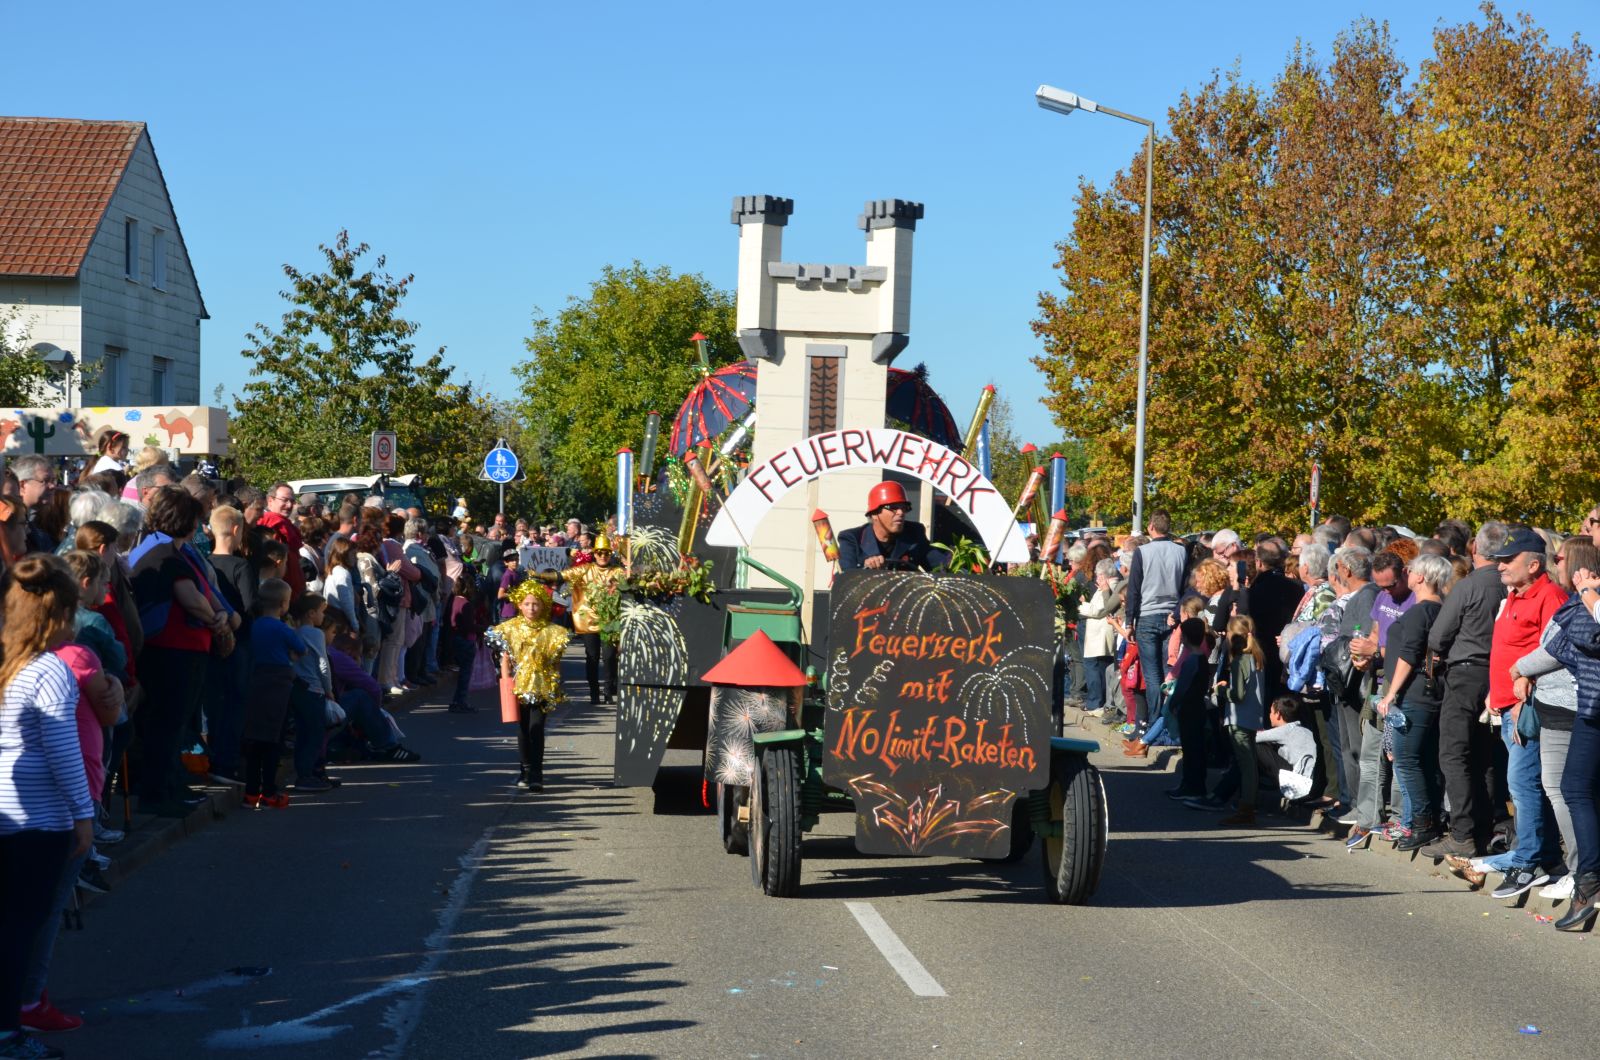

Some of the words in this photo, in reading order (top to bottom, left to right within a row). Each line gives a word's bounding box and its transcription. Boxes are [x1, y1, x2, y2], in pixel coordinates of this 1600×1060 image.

[380, 442, 389, 454] 30
[850, 600, 1003, 667] Feuerwerk
[898, 669, 954, 704] mit
